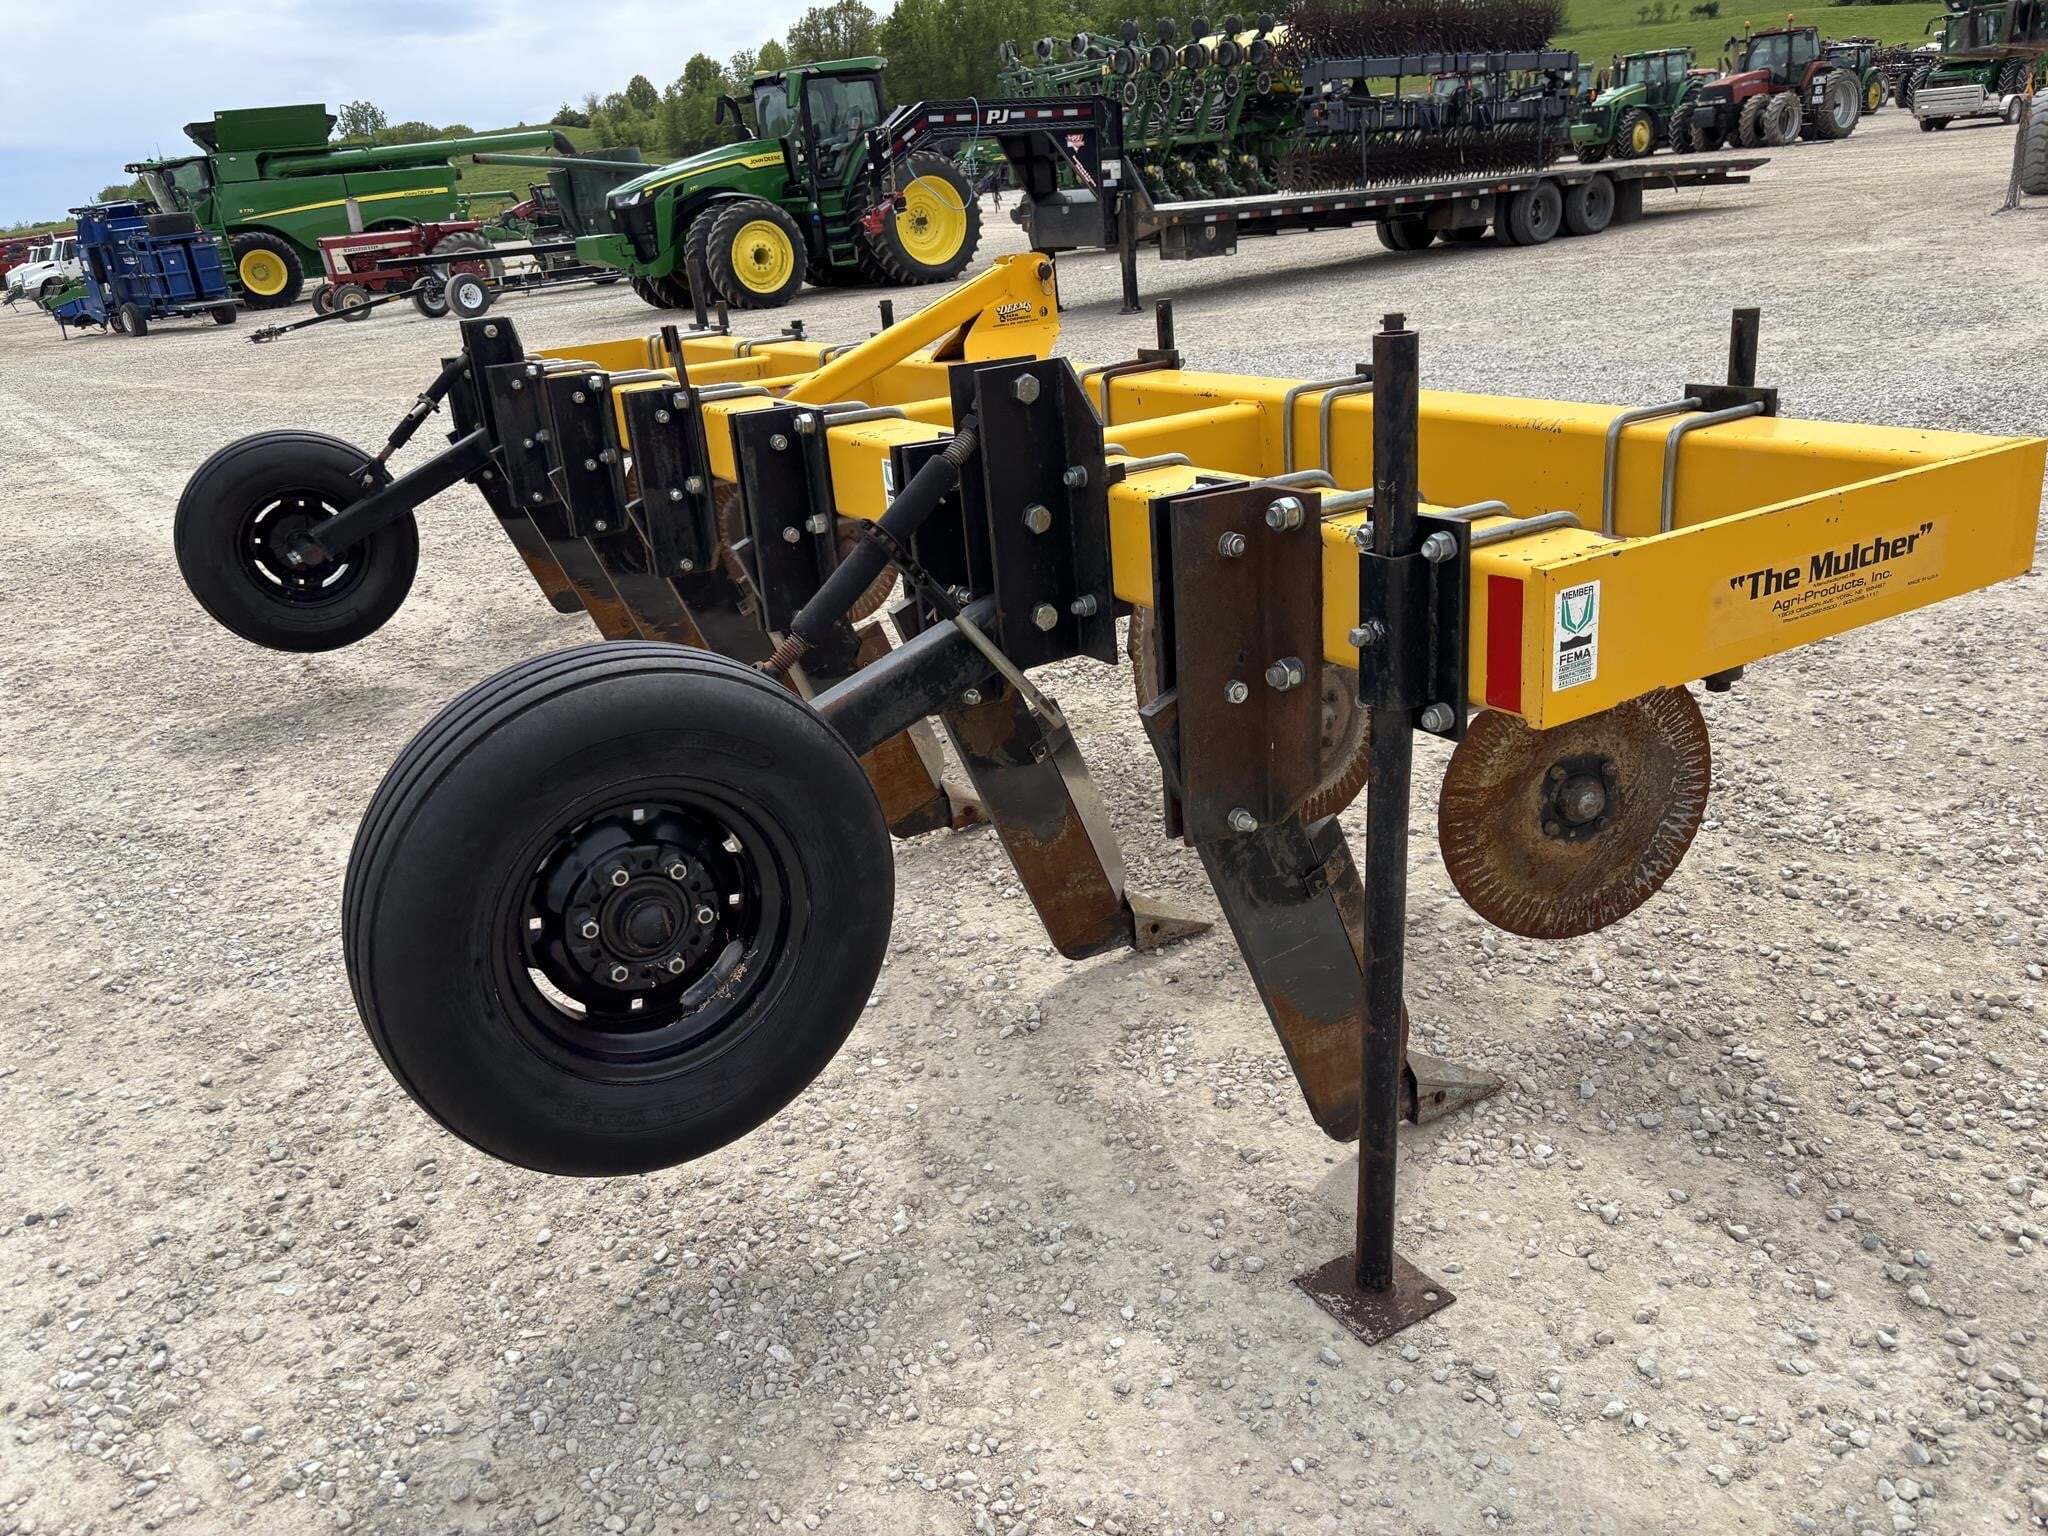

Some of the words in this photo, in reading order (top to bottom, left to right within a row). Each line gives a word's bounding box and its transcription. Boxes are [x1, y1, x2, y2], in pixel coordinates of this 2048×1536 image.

[986, 109, 1010, 124] PJ
[1730, 566, 1801, 600] "The
[1808, 522, 1934, 583] Mulcher"
[1561, 585, 1594, 601] MEMBER
[1772, 577, 1867, 612] Agri-Products,
[1871, 570, 1893, 583] Inc.
[1559, 648, 1591, 666] FEMA
